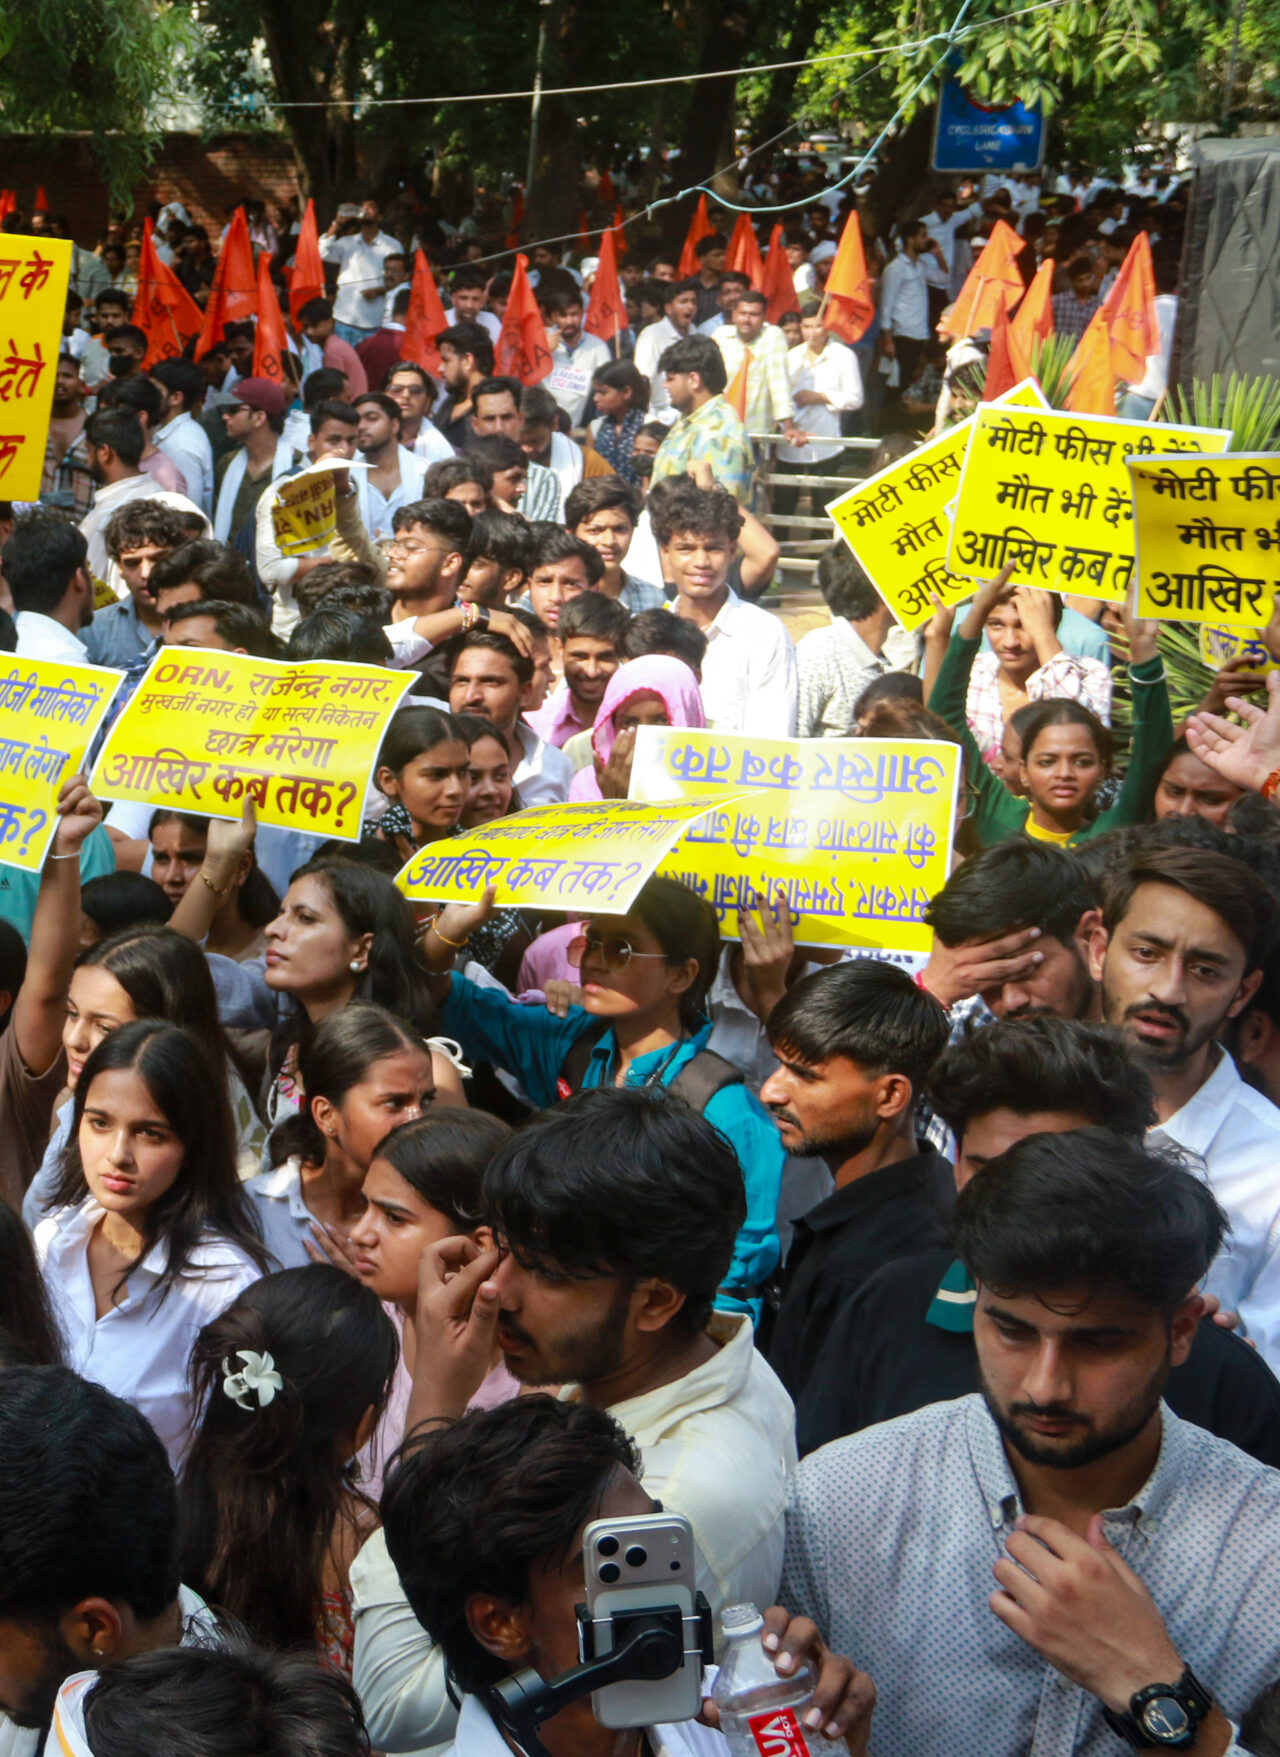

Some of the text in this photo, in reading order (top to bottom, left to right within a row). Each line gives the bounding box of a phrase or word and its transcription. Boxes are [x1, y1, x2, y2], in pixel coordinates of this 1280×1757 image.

[20, 250, 54, 300] के
[1054, 426, 1116, 466] फीस
[904, 458, 962, 492] फीस
[996, 473, 1098, 519] मौत भी
[1229, 466, 1280, 502] फी
[890, 516, 944, 556] मौत
[956, 526, 1058, 580] आखिर
[1059, 546, 1113, 587] कब
[1176, 516, 1246, 552] मौत
[1145, 563, 1266, 617] आखिर
[29, 678, 105, 727] मालिकों
[154, 664, 235, 694] ORN,
[329, 675, 393, 704] नगर,
[140, 691, 381, 731] मुखर्जी नगर हो या सत्य निकेतन
[24, 734, 71, 786] लेगा
[204, 727, 339, 769] छात्र मरेगा
[735, 748, 804, 791] कब
[103, 748, 358, 828] आखिर कब तक?
[808, 752, 946, 804] आखिर
[730, 812, 762, 858] की
[903, 822, 937, 869] की
[406, 848, 512, 890] आखिर
[505, 858, 568, 892] कब
[558, 861, 643, 902] तक?
